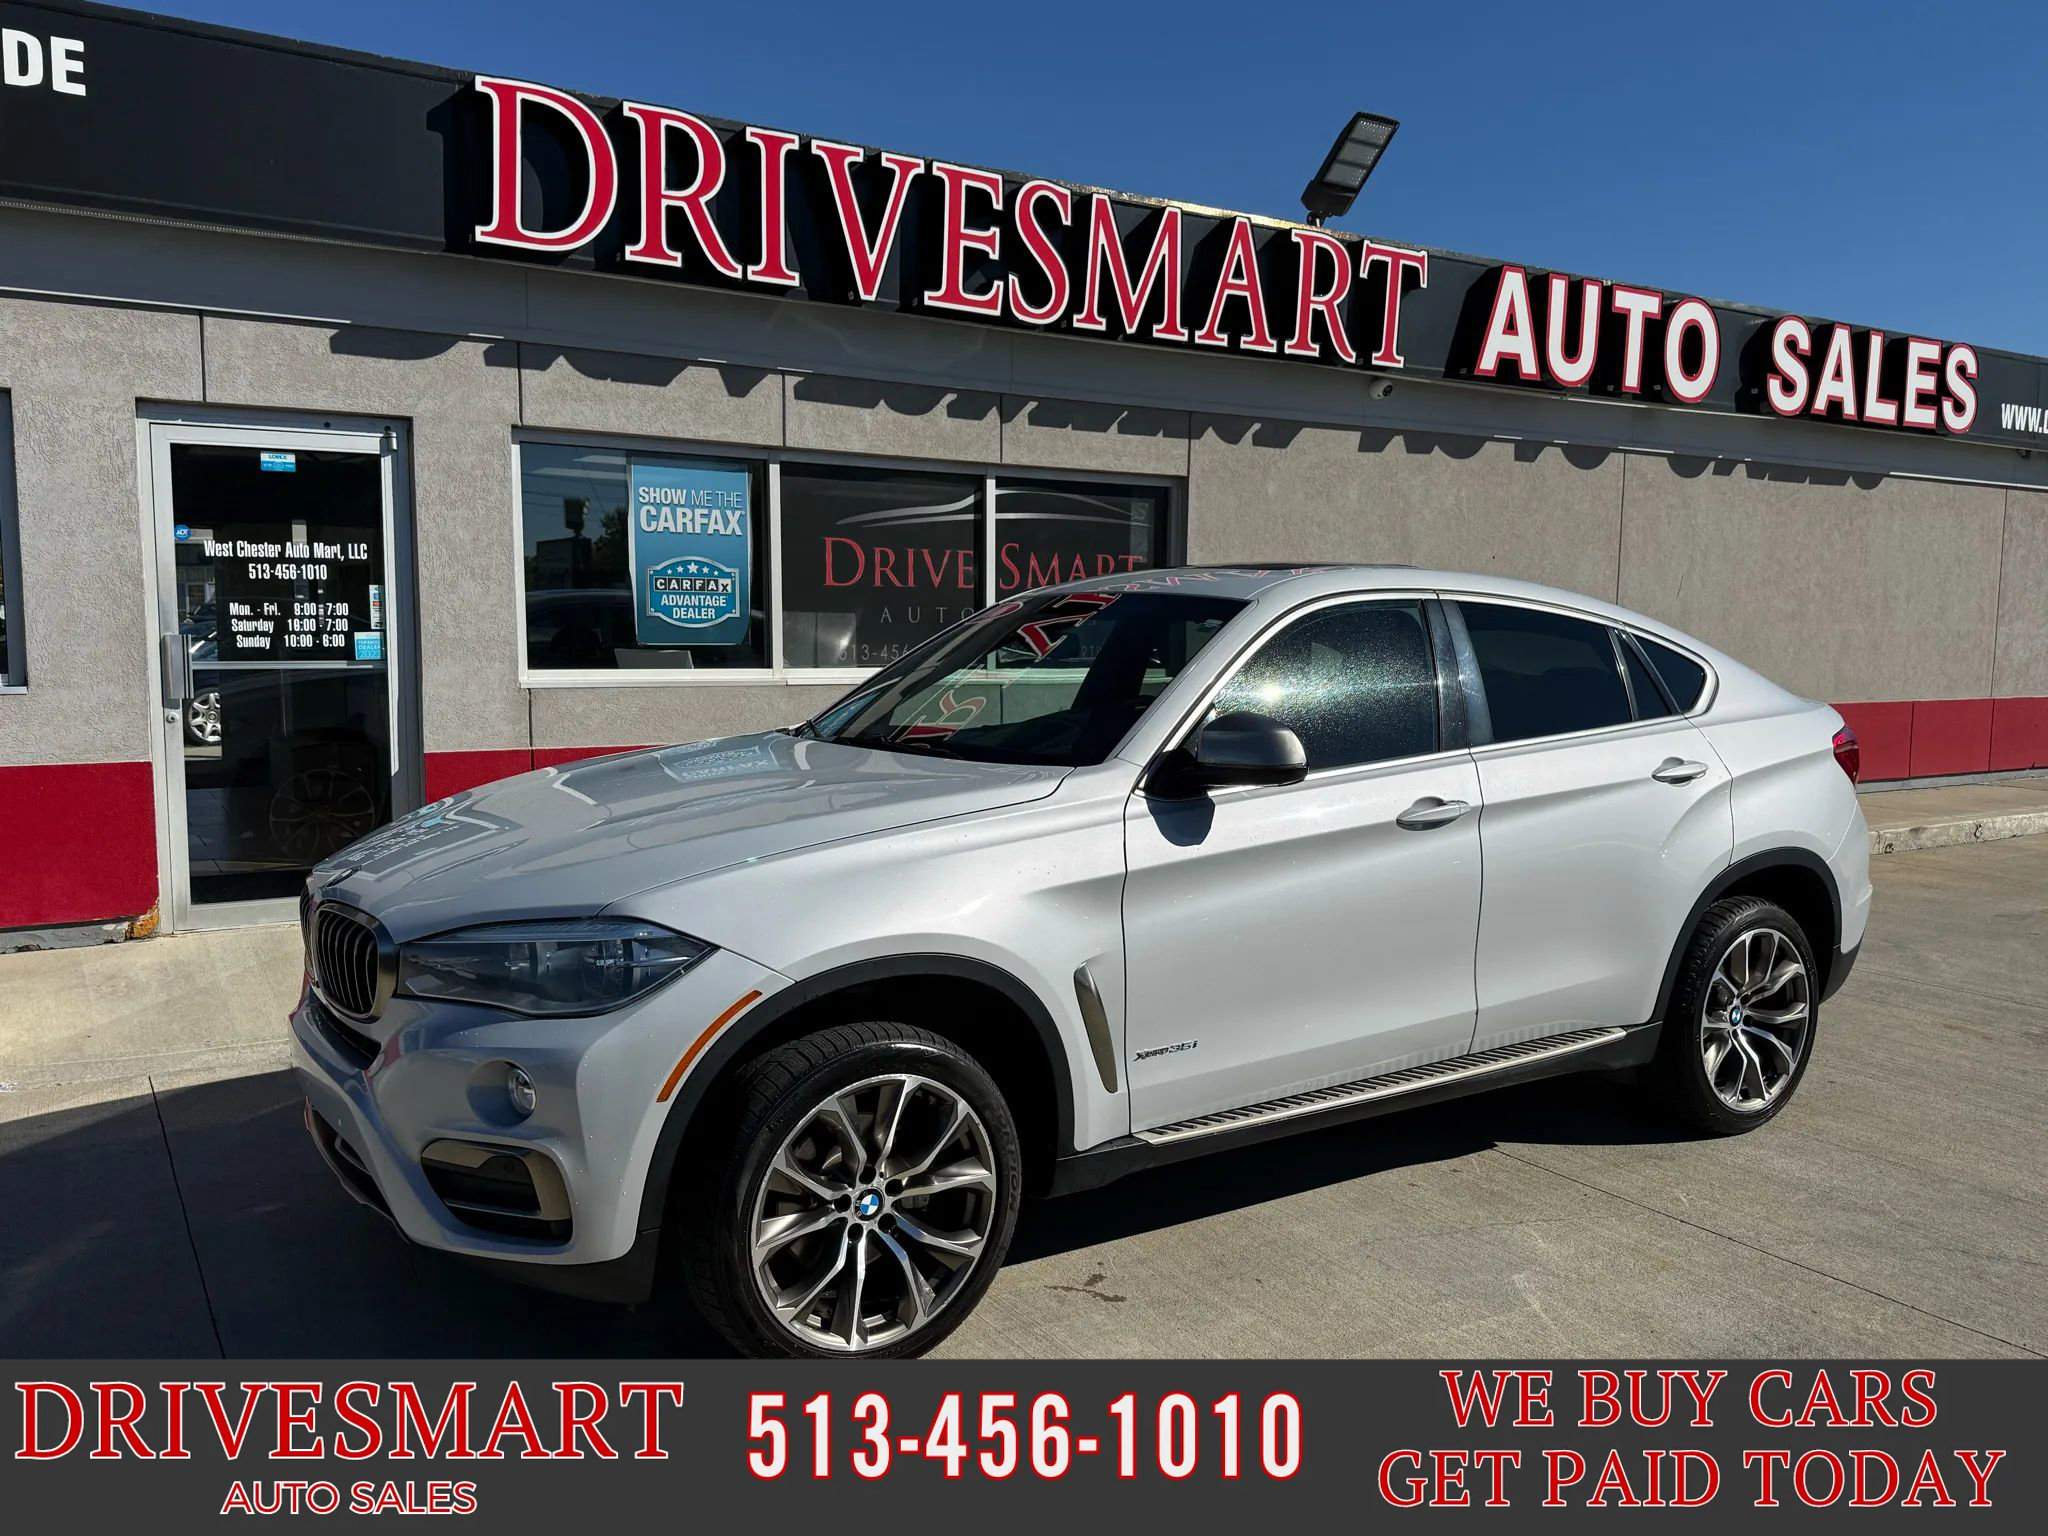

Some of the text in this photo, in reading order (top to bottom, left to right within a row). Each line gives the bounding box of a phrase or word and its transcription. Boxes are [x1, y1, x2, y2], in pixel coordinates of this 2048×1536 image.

[2, 28, 87, 97] DE
[474, 74, 1979, 435] DRIVESMART AUTO SALES
[638, 486, 742, 508] SHOW ME THE
[203, 540, 368, 562] West Chester Auto Mart, LLC
[822, 536, 975, 589] DRIVE
[248, 563, 328, 581] 513-456-1010
[655, 577, 731, 593] CARFAX
[229, 602, 254, 616] Mon.
[263, 602, 281, 616] Fri.
[293, 602, 317, 616] 9:00
[325, 602, 349, 616] 7:00
[661, 595, 727, 607] ADVANTAGE
[672, 607, 716, 619] DEALER
[880, 606, 974, 624] AUTO
[231, 618, 274, 634] Saturday
[325, 618, 349, 632] 7:00
[236, 634, 271, 650] Sunday
[284, 634, 313, 647] 10:00
[322, 634, 345, 647] 6:00
